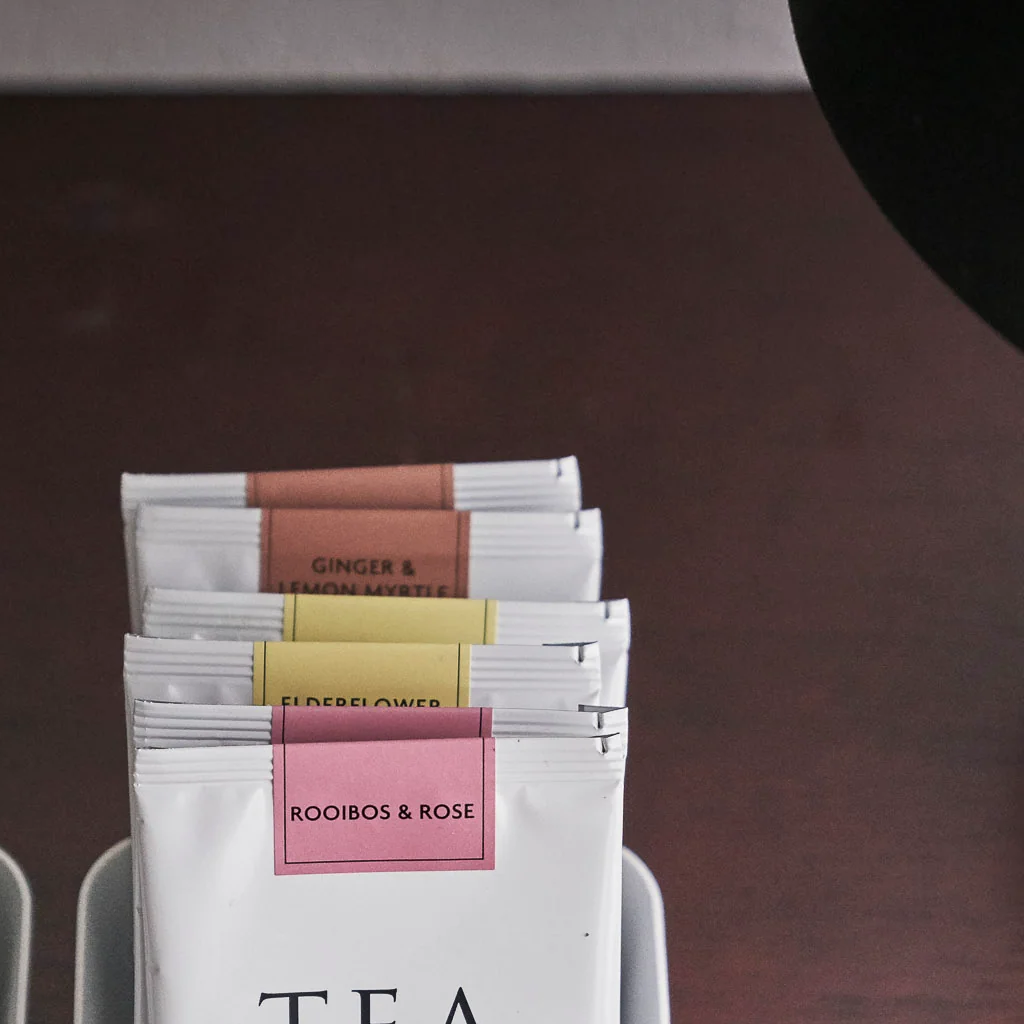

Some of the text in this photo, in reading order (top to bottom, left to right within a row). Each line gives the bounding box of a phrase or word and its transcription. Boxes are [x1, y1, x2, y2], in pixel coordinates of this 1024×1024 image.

[311, 556, 416, 576] GINGER &
[278, 580, 356, 595] LEMON
[291, 803, 475, 821] ROOIBOS & ROSE
